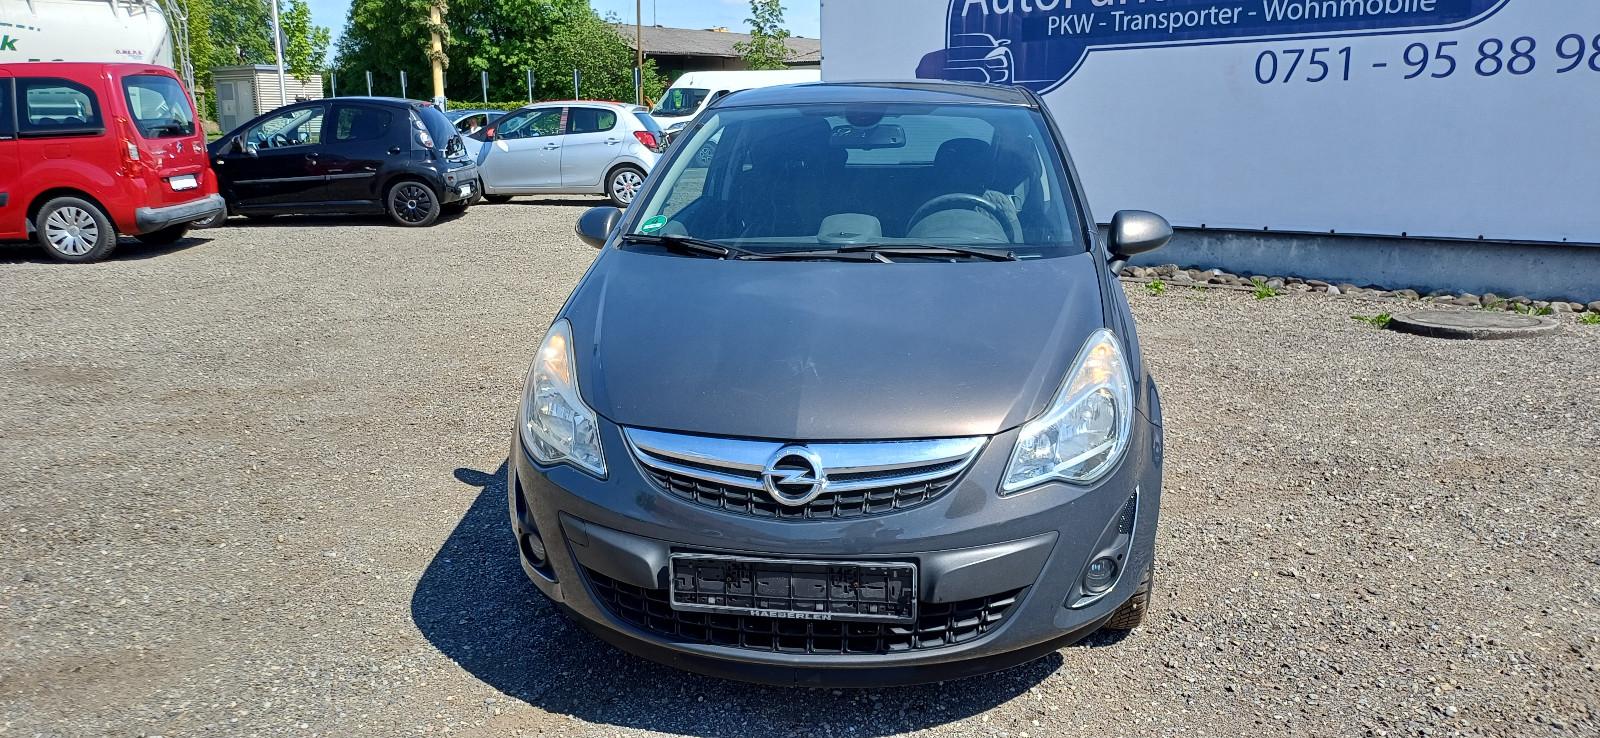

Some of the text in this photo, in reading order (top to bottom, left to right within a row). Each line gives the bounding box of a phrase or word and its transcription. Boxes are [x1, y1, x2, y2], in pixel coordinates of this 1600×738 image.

[1048, 13, 1094, 35] PKW
[1111, 6, 1242, 33] Transporter
[1263, 0, 1437, 21] Wohnmobile
[1255, 46, 1351, 84] 0751
[1403, 41, 1458, 79] 95
[1474, 36, 1536, 76] 88
[750, 610, 832, 620] HAEBERLEN
